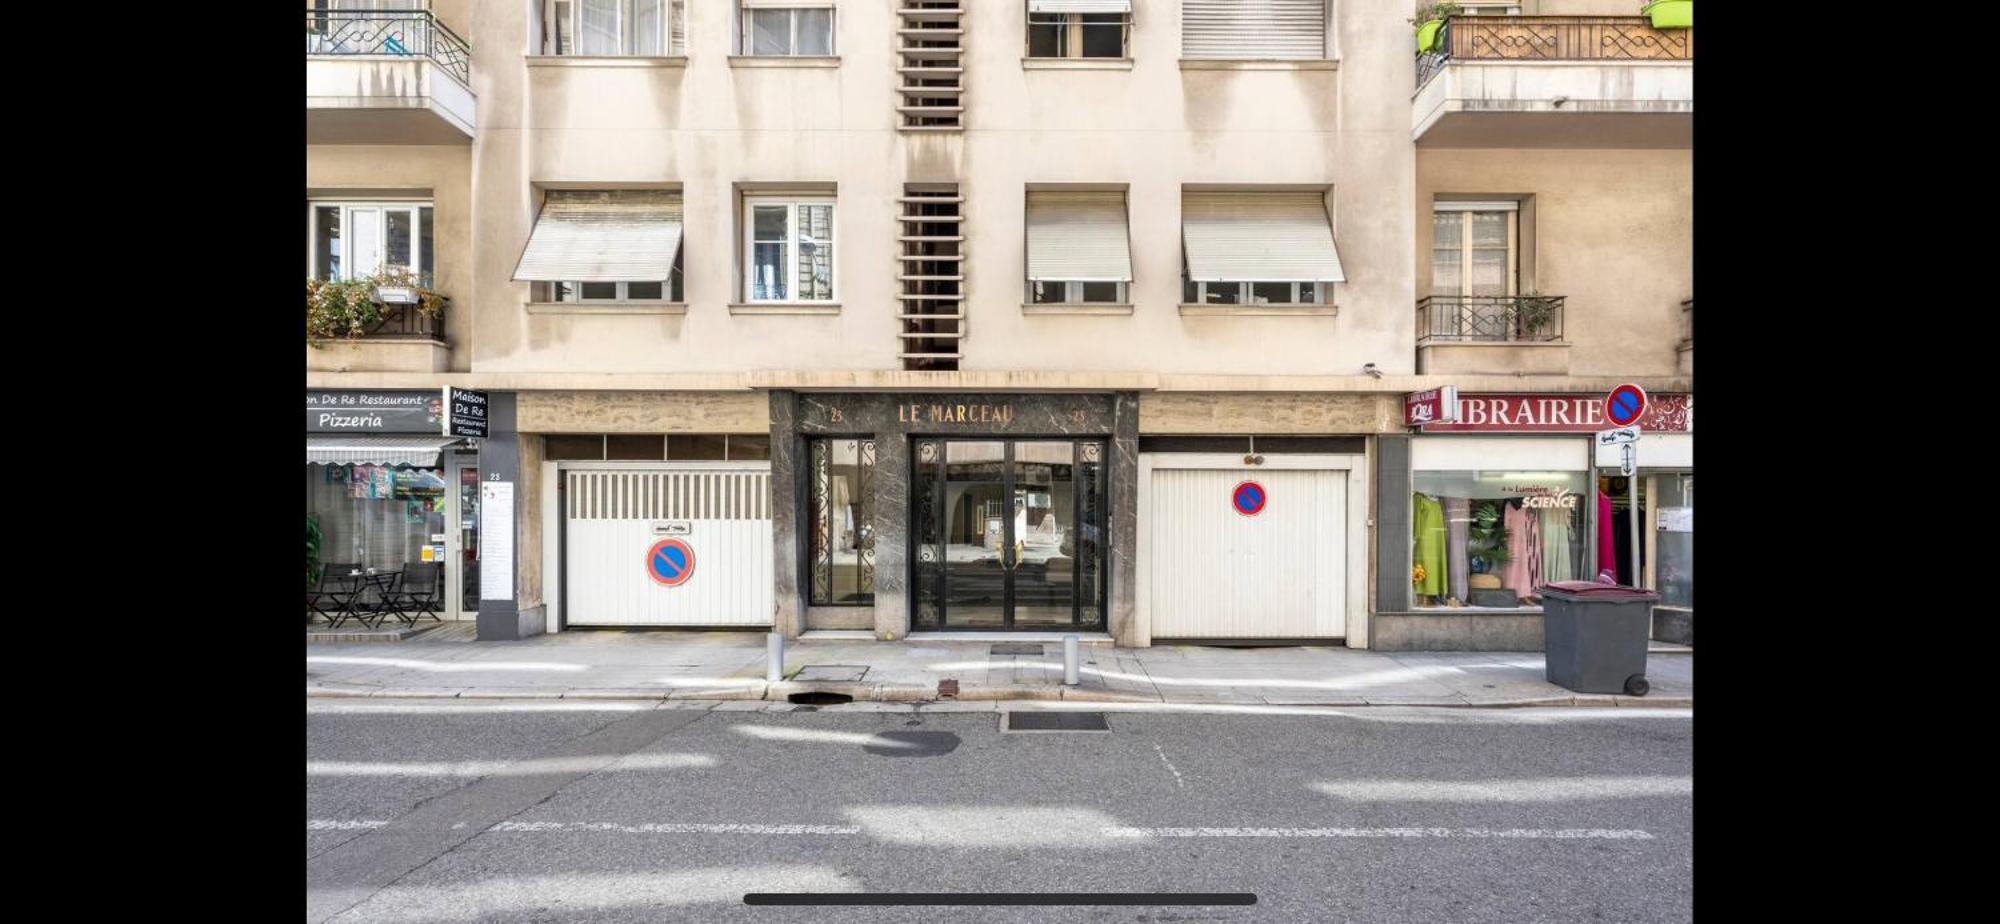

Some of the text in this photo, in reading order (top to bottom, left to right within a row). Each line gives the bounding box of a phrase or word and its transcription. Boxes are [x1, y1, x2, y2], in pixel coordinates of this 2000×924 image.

[322, 394, 337, 405] De
[340, 395, 355, 405] Re
[359, 395, 422, 405] Restaurant
[452, 390, 486, 404] Maison
[455, 403, 484, 417] De Re
[899, 404, 1013, 423] LE MARCEAU
[1436, 399, 1604, 425] IBRAIRIE
[319, 412, 383, 428] Pizzeria
[452, 417, 486, 427] Restaurant
[1521, 496, 1577, 509] SCIENCE
